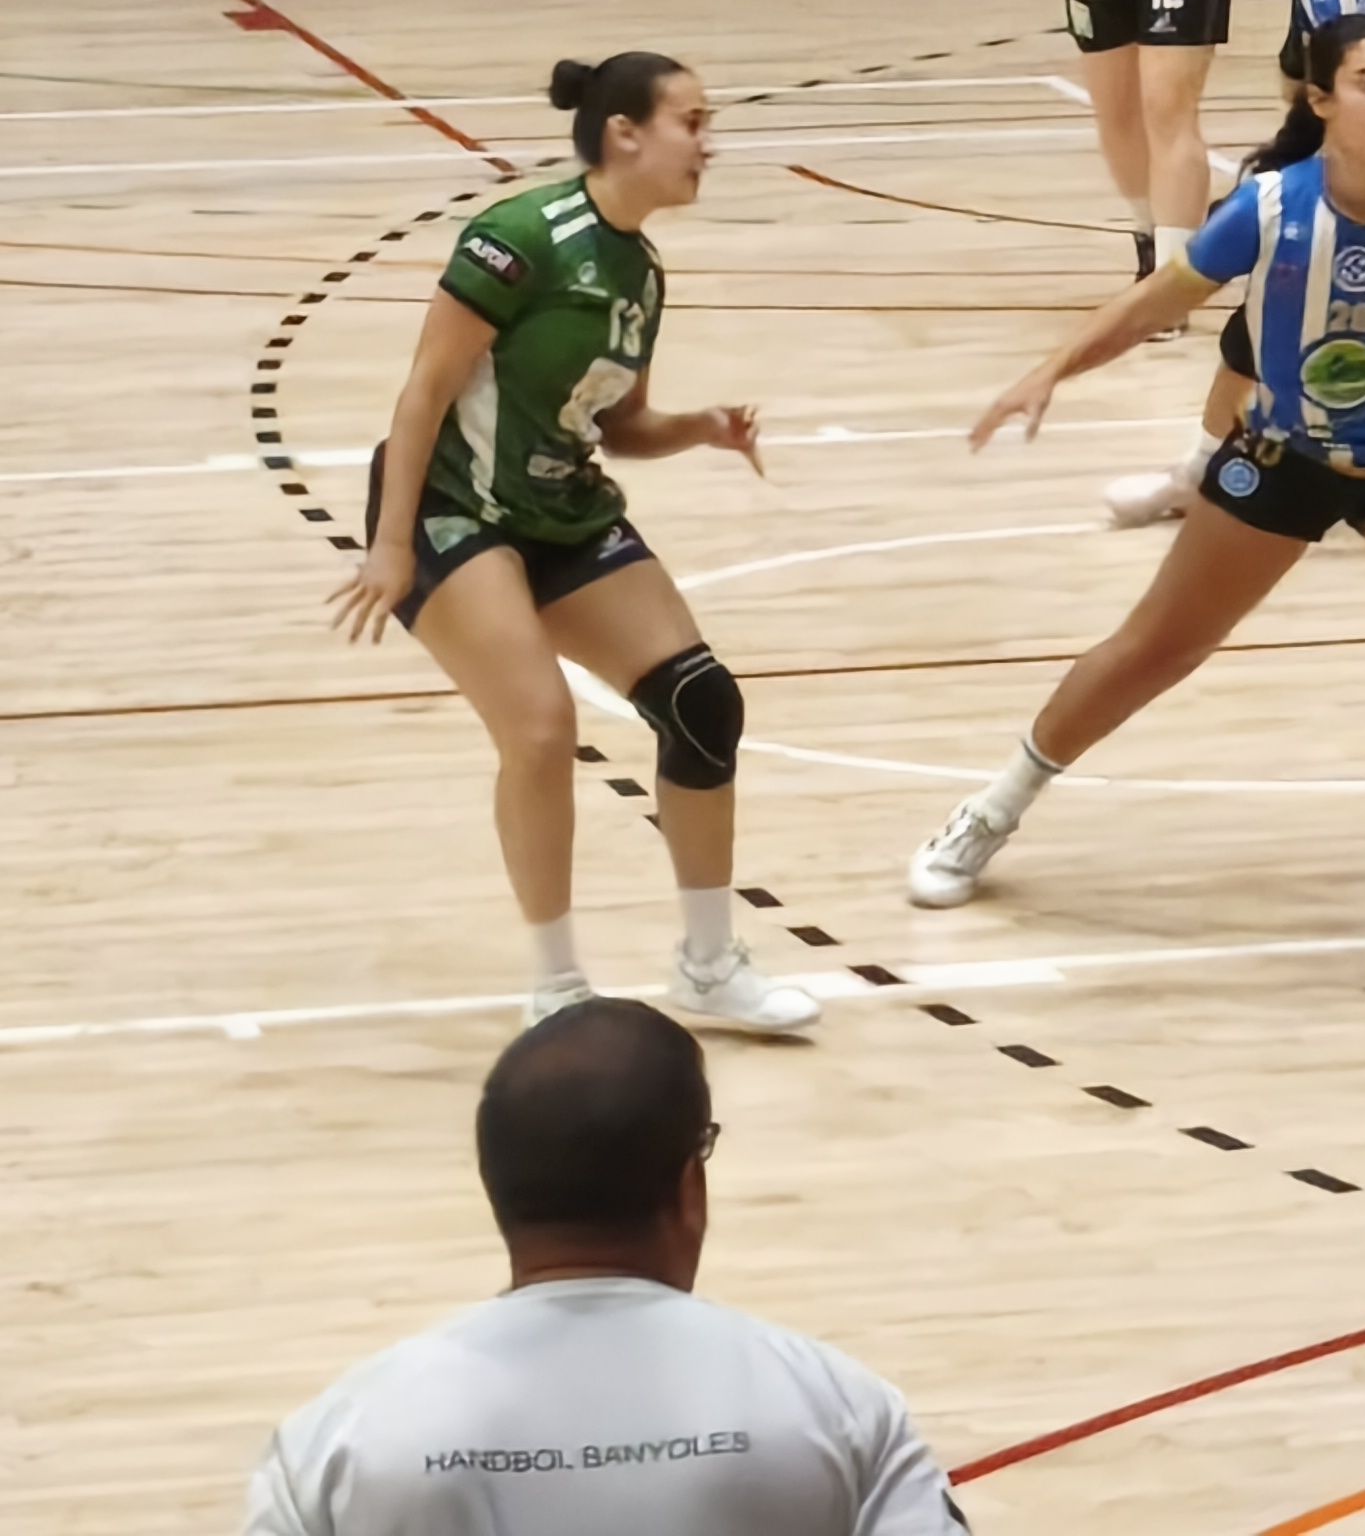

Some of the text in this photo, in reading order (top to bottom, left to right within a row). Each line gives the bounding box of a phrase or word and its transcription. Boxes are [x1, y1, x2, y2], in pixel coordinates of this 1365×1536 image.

[610, 298, 646, 357] 13
[425, 1430, 751, 1474] HANDBOL BANYOLES
